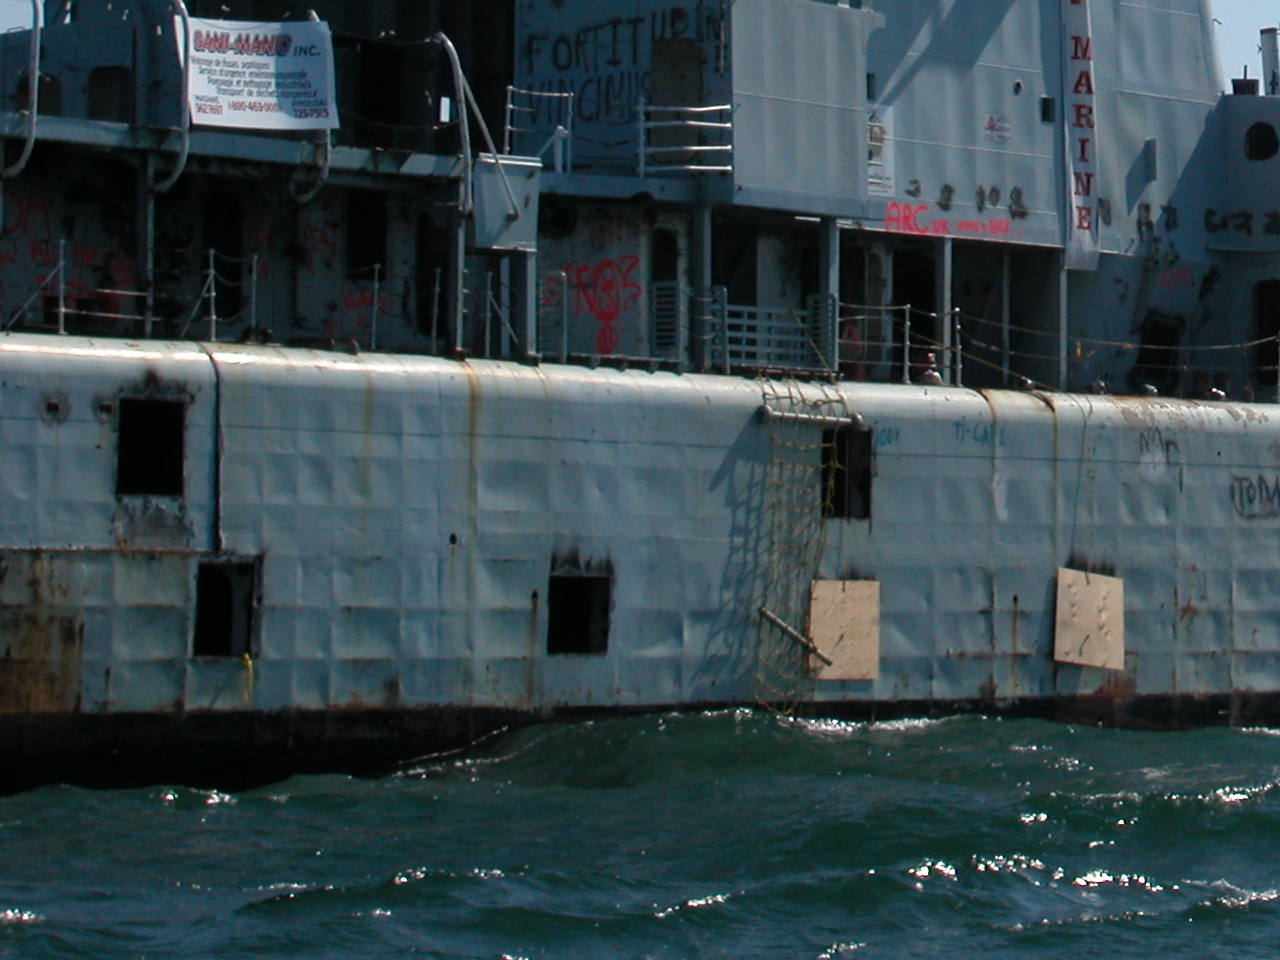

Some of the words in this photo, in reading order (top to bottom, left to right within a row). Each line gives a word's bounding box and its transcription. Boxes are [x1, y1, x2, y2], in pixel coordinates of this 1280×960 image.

[294, 45, 320, 57] INC.
[1070, 35, 1094, 232] MARINE
[884, 202, 929, 234] ARC
